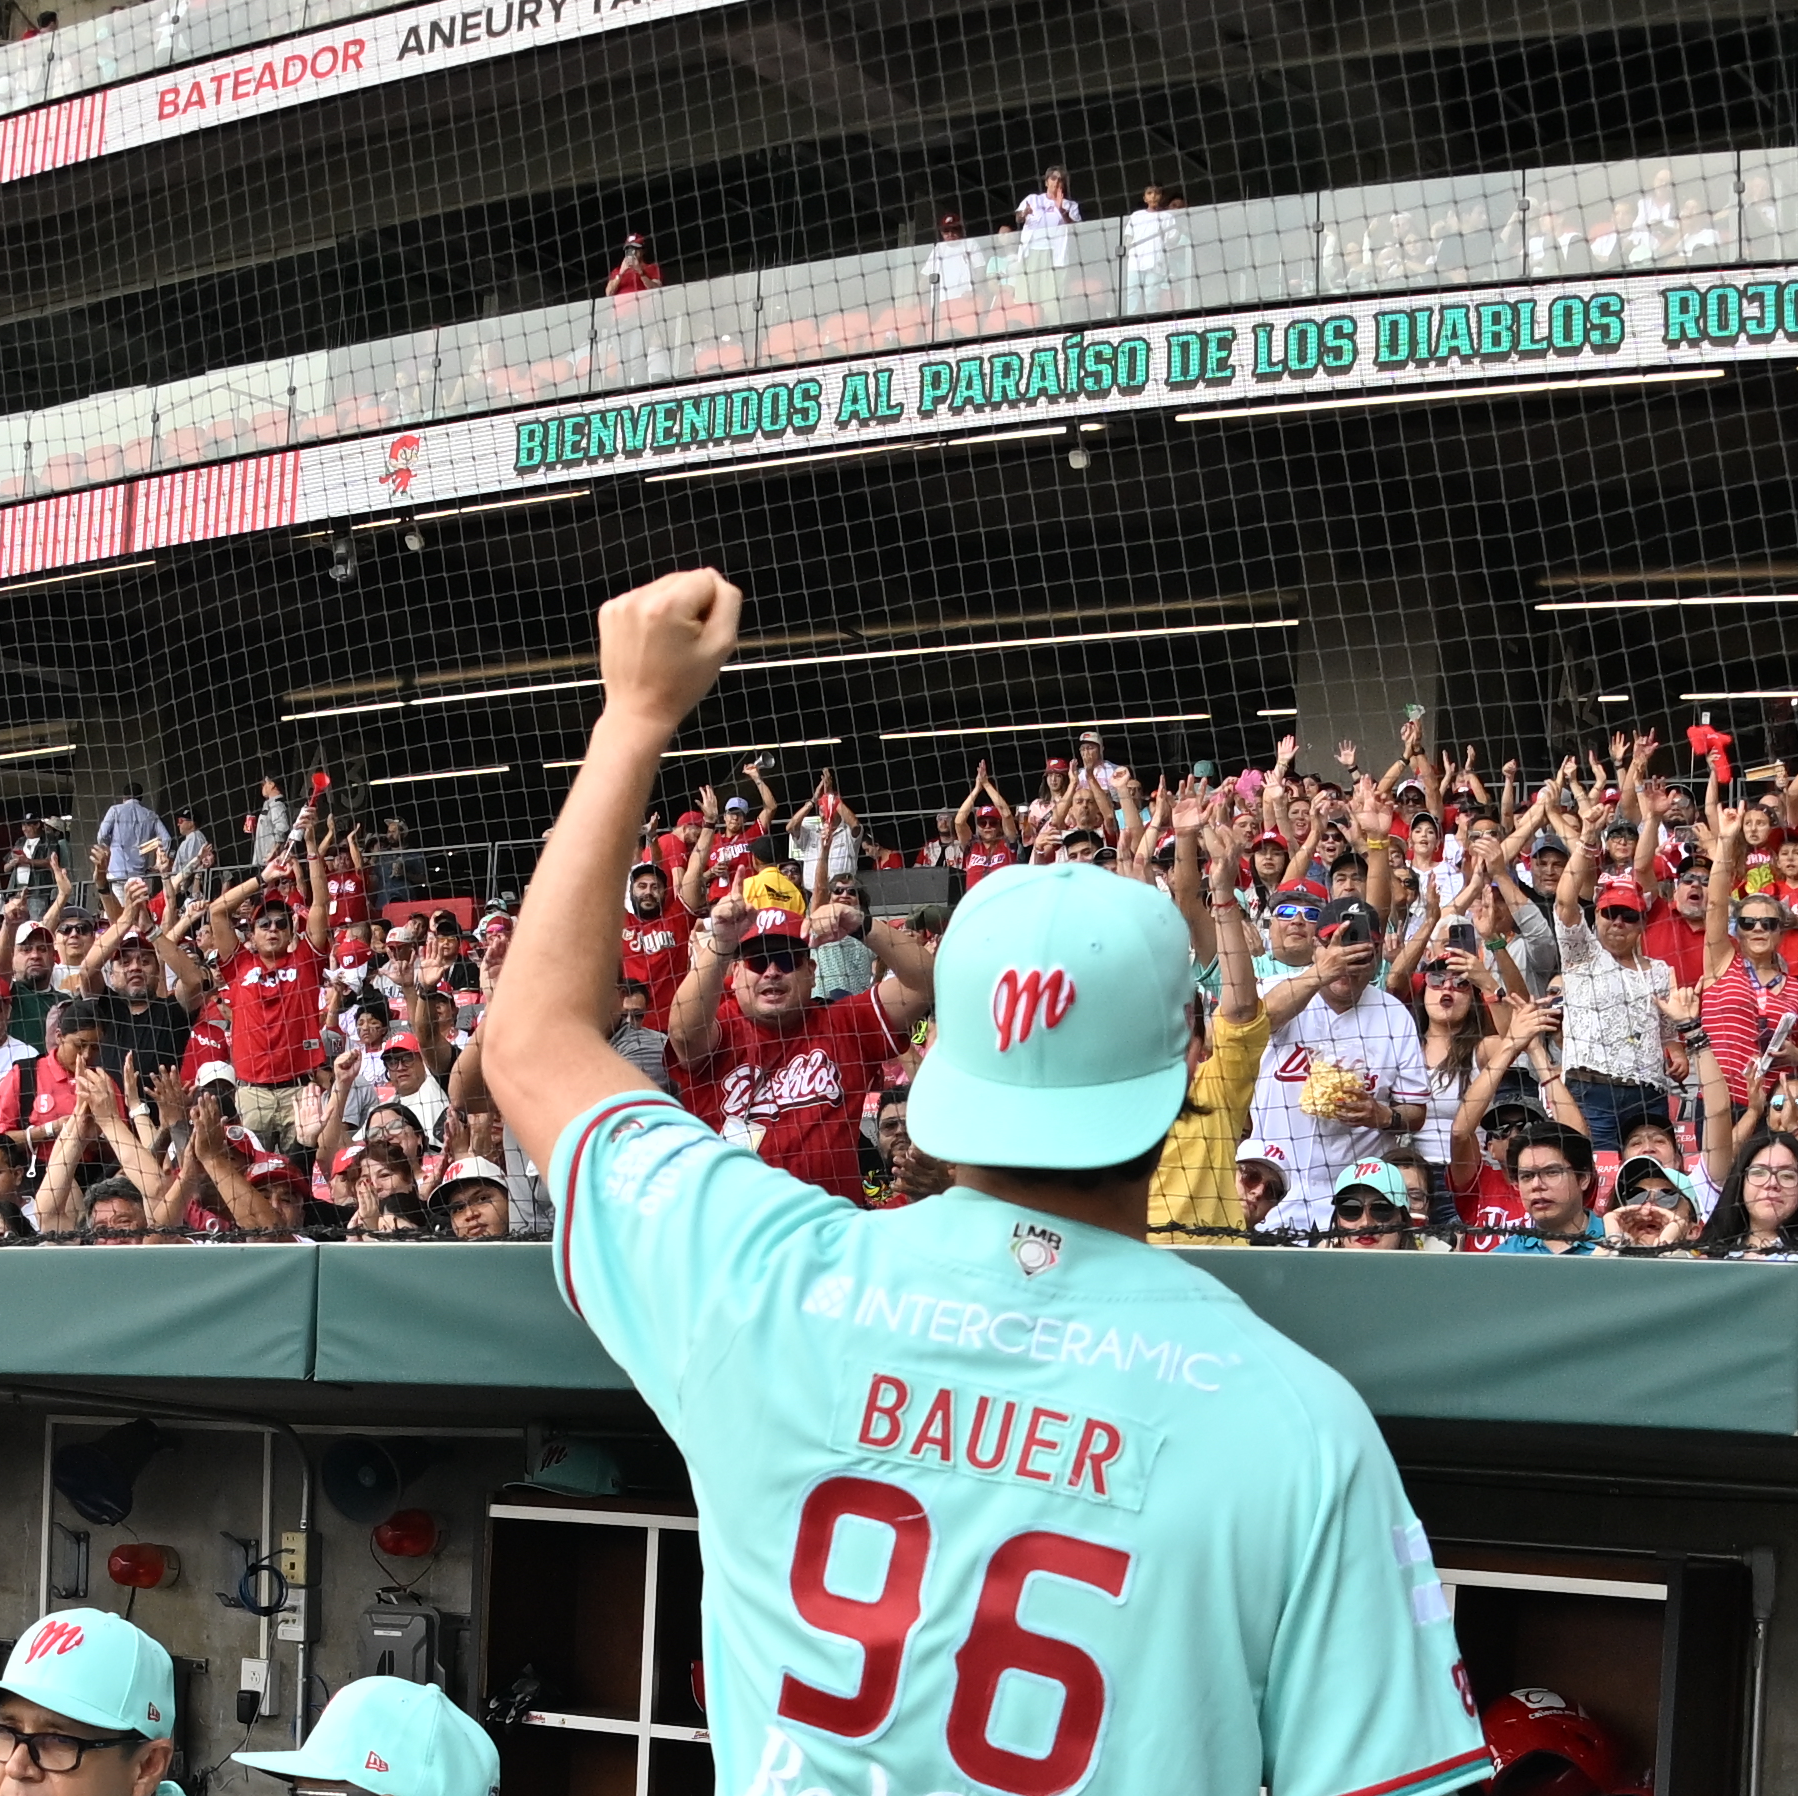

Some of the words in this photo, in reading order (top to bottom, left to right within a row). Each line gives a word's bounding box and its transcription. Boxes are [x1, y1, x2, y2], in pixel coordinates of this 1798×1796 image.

[157, 38, 366, 122] BATEADOR
[515, 378, 823, 473] BIENVENIDOS
[837, 369, 904, 429] AL
[920, 333, 1150, 416] PARAÍSO
[1166, 328, 1237, 390] DE
[1251, 314, 1359, 384] LOS
[1372, 292, 1625, 372] DIABLOS
[1013, 1222, 1063, 1252] LMB
[854, 1285, 1221, 1393] INTERCERAMIC
[857, 1371, 1123, 1497] BAUER
